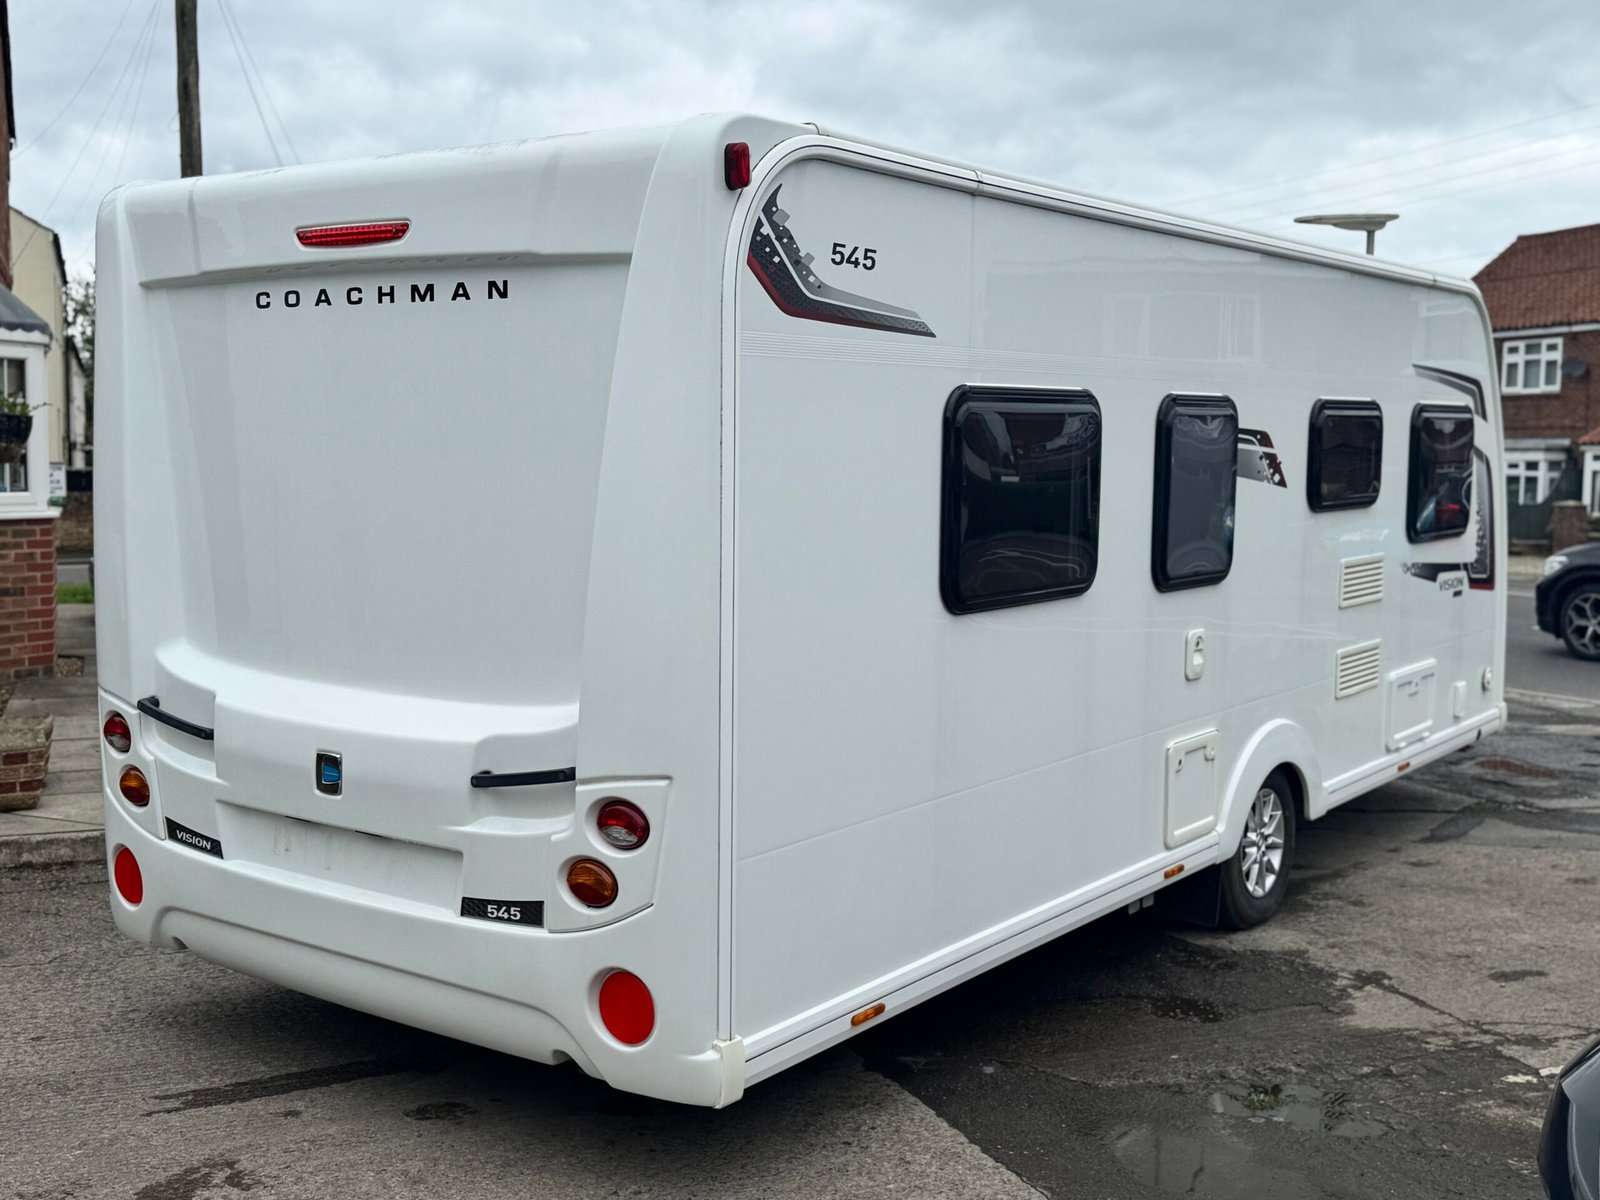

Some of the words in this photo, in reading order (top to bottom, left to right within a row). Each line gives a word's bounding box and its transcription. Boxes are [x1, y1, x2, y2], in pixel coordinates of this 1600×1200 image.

[830, 242, 877, 271] 545
[255, 279, 509, 309] COACHMAN
[1439, 577, 1464, 592] VISION
[176, 829, 211, 850] VISION
[487, 904, 521, 920] 545
